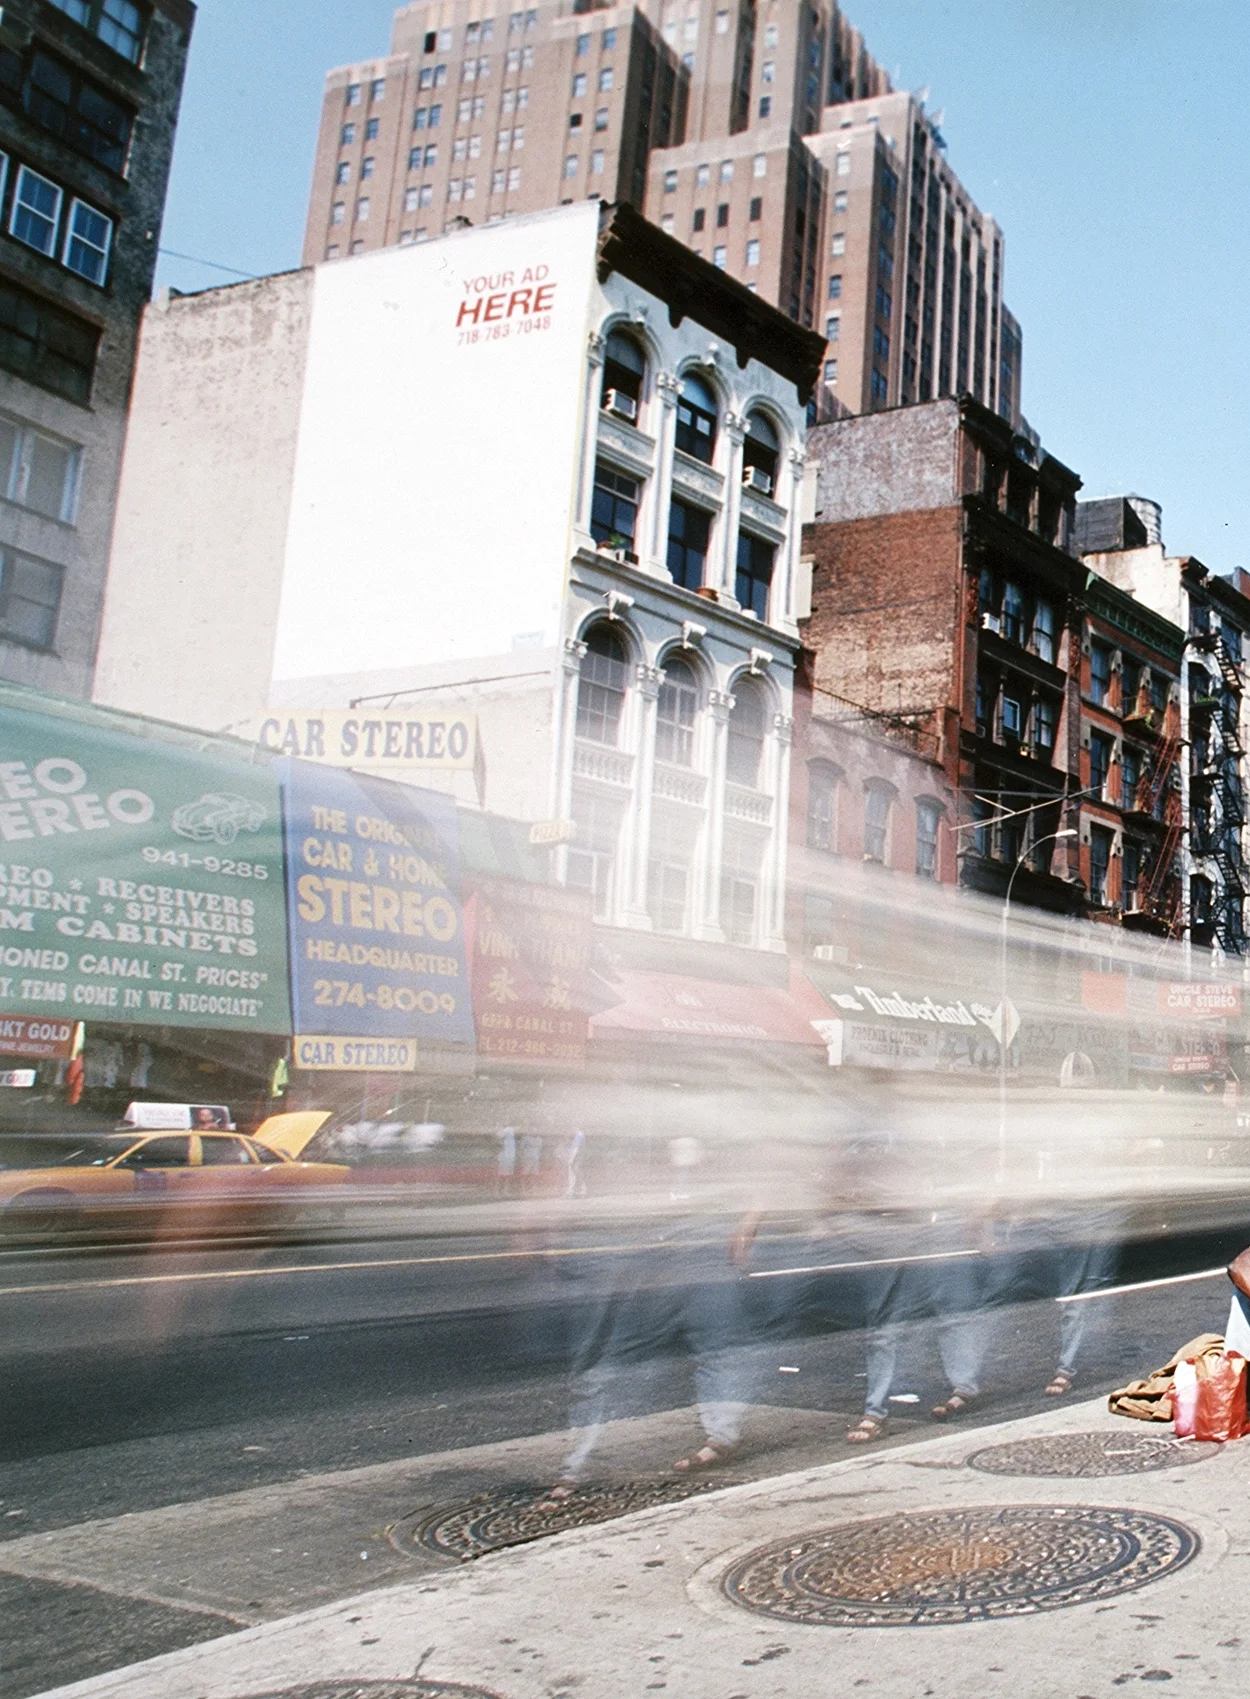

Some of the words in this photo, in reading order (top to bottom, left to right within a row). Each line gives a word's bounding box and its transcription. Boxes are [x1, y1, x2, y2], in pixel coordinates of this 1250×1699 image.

[464, 271, 515, 294] YOUR
[521, 264, 549, 284] AD
[456, 283, 558, 327] HERE
[259, 717, 326, 758] CAR
[341, 719, 469, 760] STEREO
[311, 805, 348, 835] THE
[140, 846, 269, 880] 941-9285
[303, 837, 352, 872] CAR
[363, 847, 380, 877] &
[388, 853, 448, 890] HOME
[96, 876, 256, 918] RECEIVERS
[297, 874, 458, 942] STEREO
[125, 902, 255, 936] SPEAKERS
[55, 916, 259, 957] CABINETS
[78, 953, 152, 980] CANAL
[160, 961, 188, 983] ST.
[306, 938, 460, 977] HEADQUARTER
[20, 979, 67, 1002] TEMS
[72, 983, 119, 1007] COME
[123, 988, 143, 1008] IN
[146, 990, 172, 1011] WE
[313, 979, 455, 1014] 274-8009
[853, 985, 977, 1026] Timberland
[1167, 995, 1192, 1007] CAR
[1196, 995, 1237, 1008] STEREO
[28, 1023, 71, 1041] GOLD
[300, 1042, 336, 1064] CAR
[343, 1043, 409, 1066] STEREO
